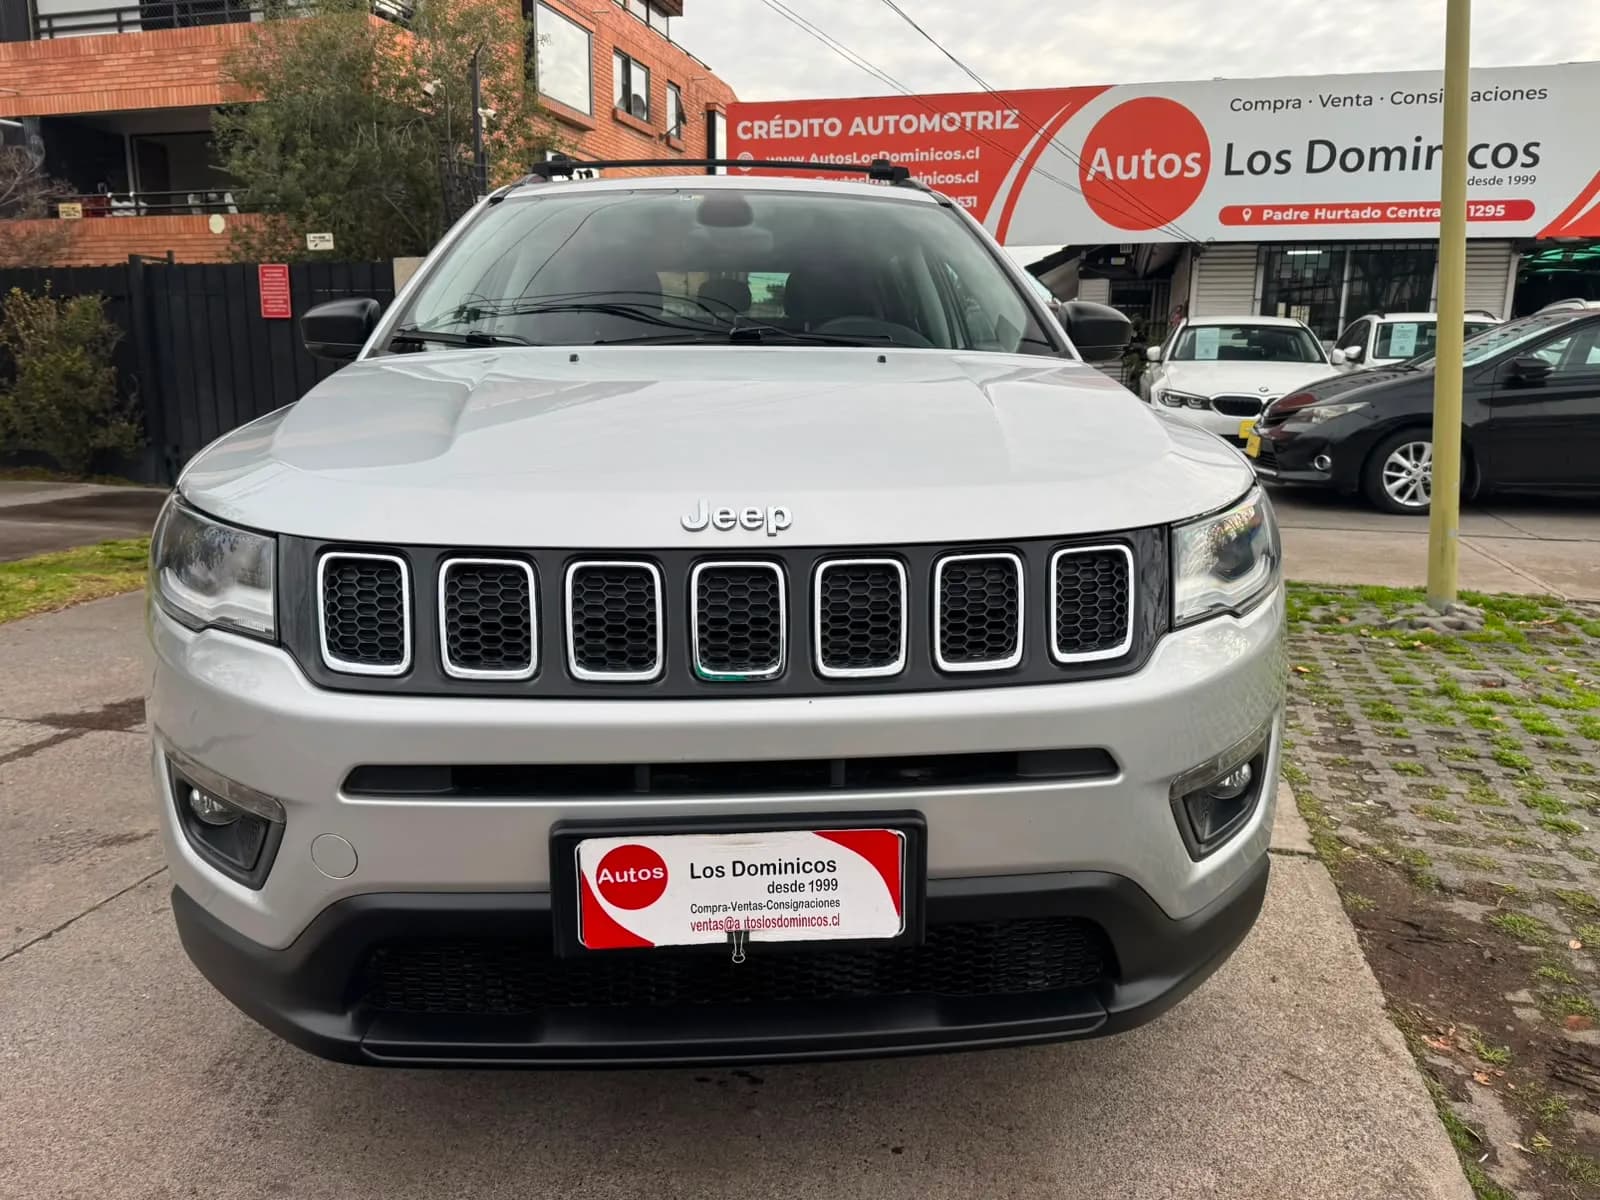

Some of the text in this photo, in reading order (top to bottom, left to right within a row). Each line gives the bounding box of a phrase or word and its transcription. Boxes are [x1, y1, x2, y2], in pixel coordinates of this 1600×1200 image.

[1230, 86, 1548, 115] Compra Venta Consiaciones
[736, 109, 1020, 140] CRÉDITO AUTOMOTRIZ
[1086, 147, 1202, 182] Autos
[1224, 135, 1541, 176] Los Domincos
[1467, 175, 1537, 186] desde 1999
[1263, 204, 1506, 221] Padre Hurtado Centra 1295
[680, 498, 793, 537] Jeep
[598, 865, 665, 884] Autos
[690, 857, 837, 879] Los Dominicos
[767, 878, 839, 894] desde 1999
[690, 898, 841, 915] Compra-Ventas-Consignaciones
